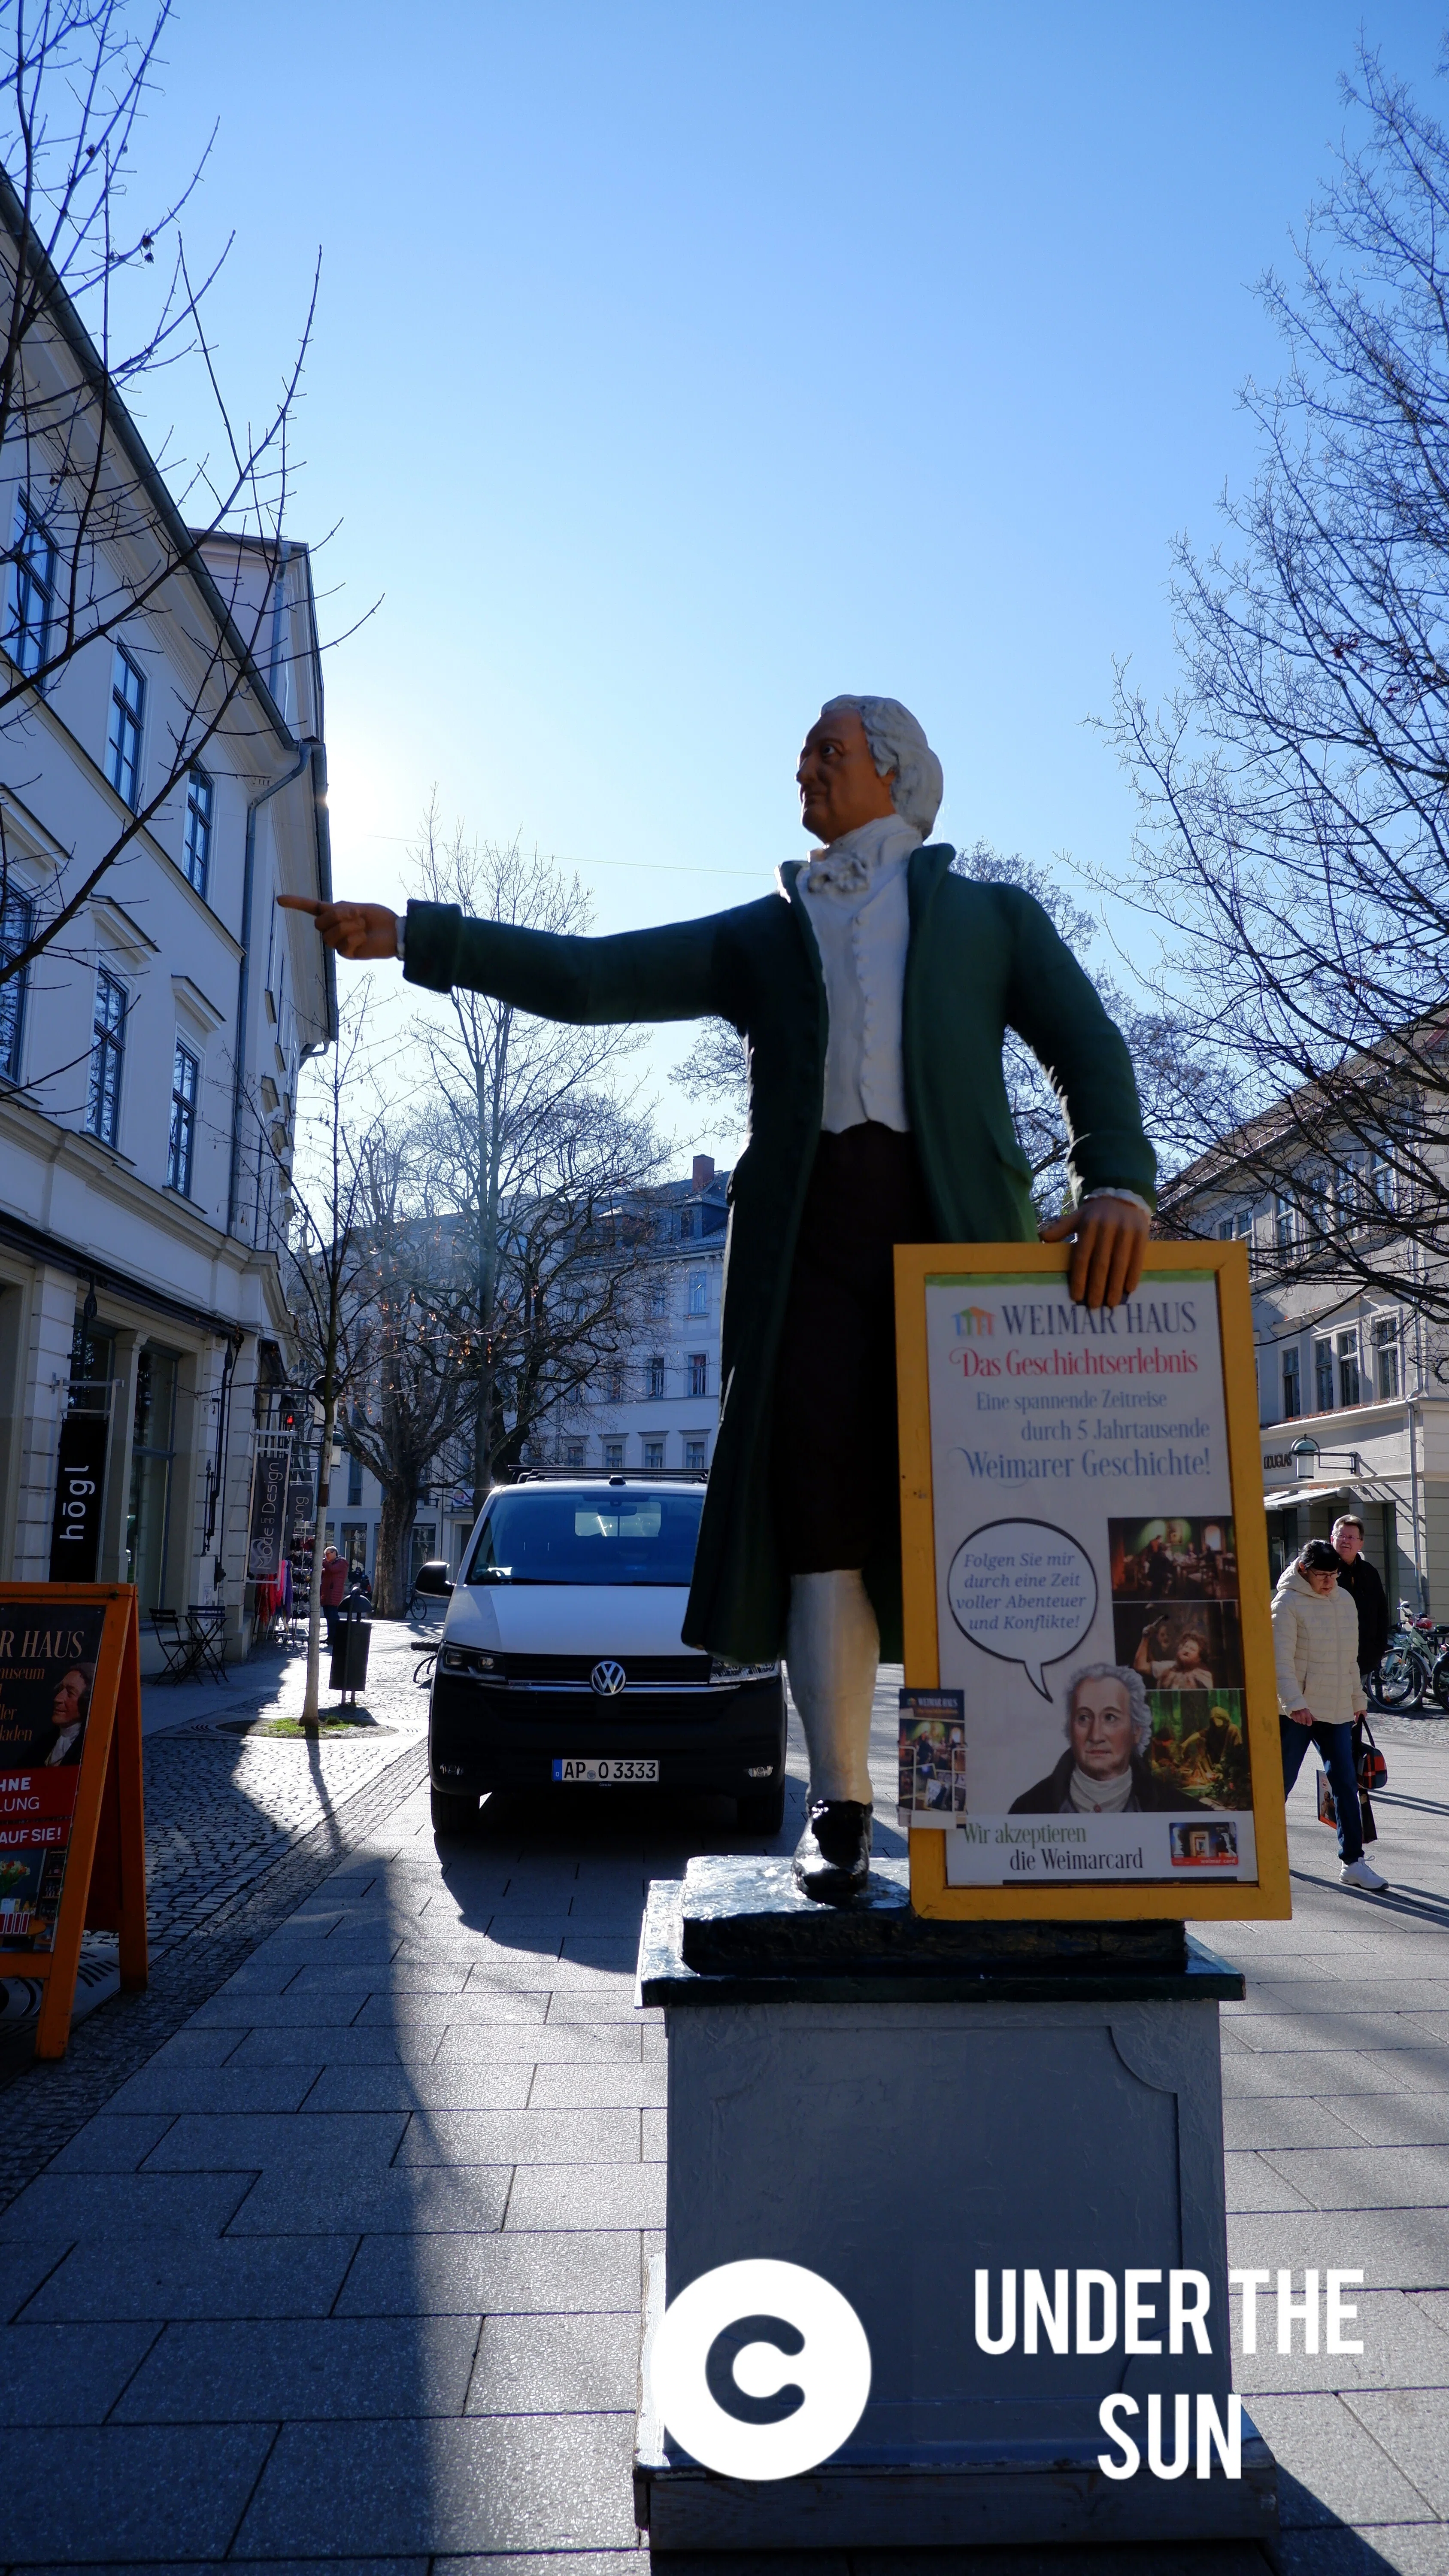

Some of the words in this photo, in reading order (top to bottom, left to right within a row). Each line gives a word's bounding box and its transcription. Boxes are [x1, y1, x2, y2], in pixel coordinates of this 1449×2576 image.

[1001, 1304, 1117, 1335] WEIMAR
[1127, 1302, 1196, 1334] HAUS
[949, 1346, 1001, 1377] Das
[1006, 1347, 1198, 1376] Geschichtserlebnis
[977, 1391, 1009, 1411] Eine
[1014, 1390, 1097, 1415] spannende
[1102, 1389, 1167, 1409] Zeitreise
[1021, 1420, 1071, 1441] durch
[1076, 1422, 1088, 1440] 5
[1093, 1418, 1210, 1440] Jahrtausende
[948, 1447, 1074, 1487] Weimarer
[1082, 1447, 1211, 1477] Geschichte!
[964, 1553, 1015, 1571] Folgen
[1019, 1553, 1042, 1567] Sie
[1046, 1552, 1075, 1566] mir
[964, 1574, 1010, 1588] durch
[1015, 1574, 1046, 1587] eine
[1050, 1573, 1081, 1587] Zeit
[956, 1595, 1001, 1609] voller
[1005, 1594, 1087, 1608] Abenteuer
[969, 1615, 999, 1630] und
[1003, 1614, 1080, 1632] Konflikte!
[20, 1631, 85, 1658] HAUS
[564, 1762, 586, 1778] AP
[598, 1762, 609, 1779] O
[613, 1762, 656, 1779] 3333
[31, 1827, 61, 1842] SIE!
[964, 1823, 990, 1844] Wir
[995, 1823, 1087, 1849] akzeptieren
[1010, 1849, 1036, 1871] die
[1040, 1847, 1143, 1870] Weimarcard
